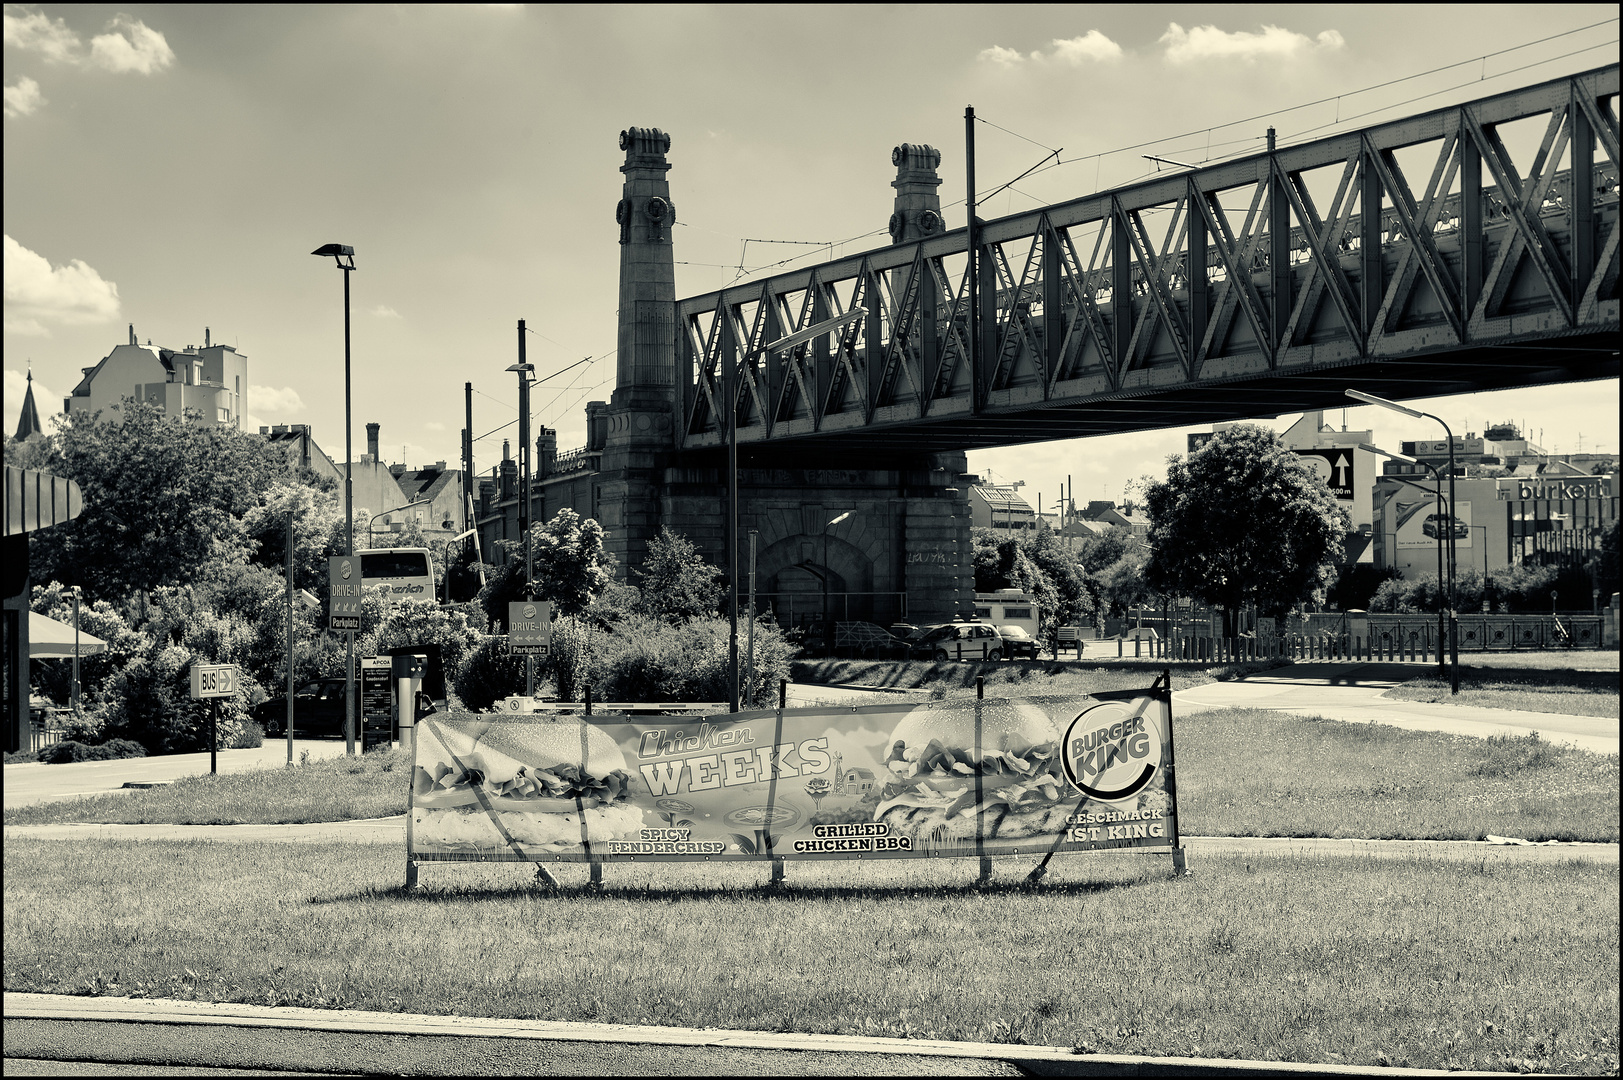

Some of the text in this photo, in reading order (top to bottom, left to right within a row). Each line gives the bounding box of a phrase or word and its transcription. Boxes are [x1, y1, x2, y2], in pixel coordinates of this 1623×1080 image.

[332, 584, 360, 597] DRIVE-IN
[332, 617, 358, 629] Parkplatz
[511, 621, 548, 631] DRIVE-IN
[512, 646, 547, 654] Parkplatz
[202, 673, 216, 690] BUS
[638, 723, 755, 760] Chicken
[1071, 716, 1146, 759] BURGER
[1074, 732, 1150, 784] KING
[639, 737, 831, 797] WEEKS
[1065, 808, 1164, 825] GESCHMACK
[639, 828, 691, 842] SPICY
[813, 824, 889, 838] GRILLED
[1066, 822, 1164, 843] IST KING
[607, 840, 725, 855] TENDERCRISP
[793, 837, 912, 852] CHICKEN BBQ
